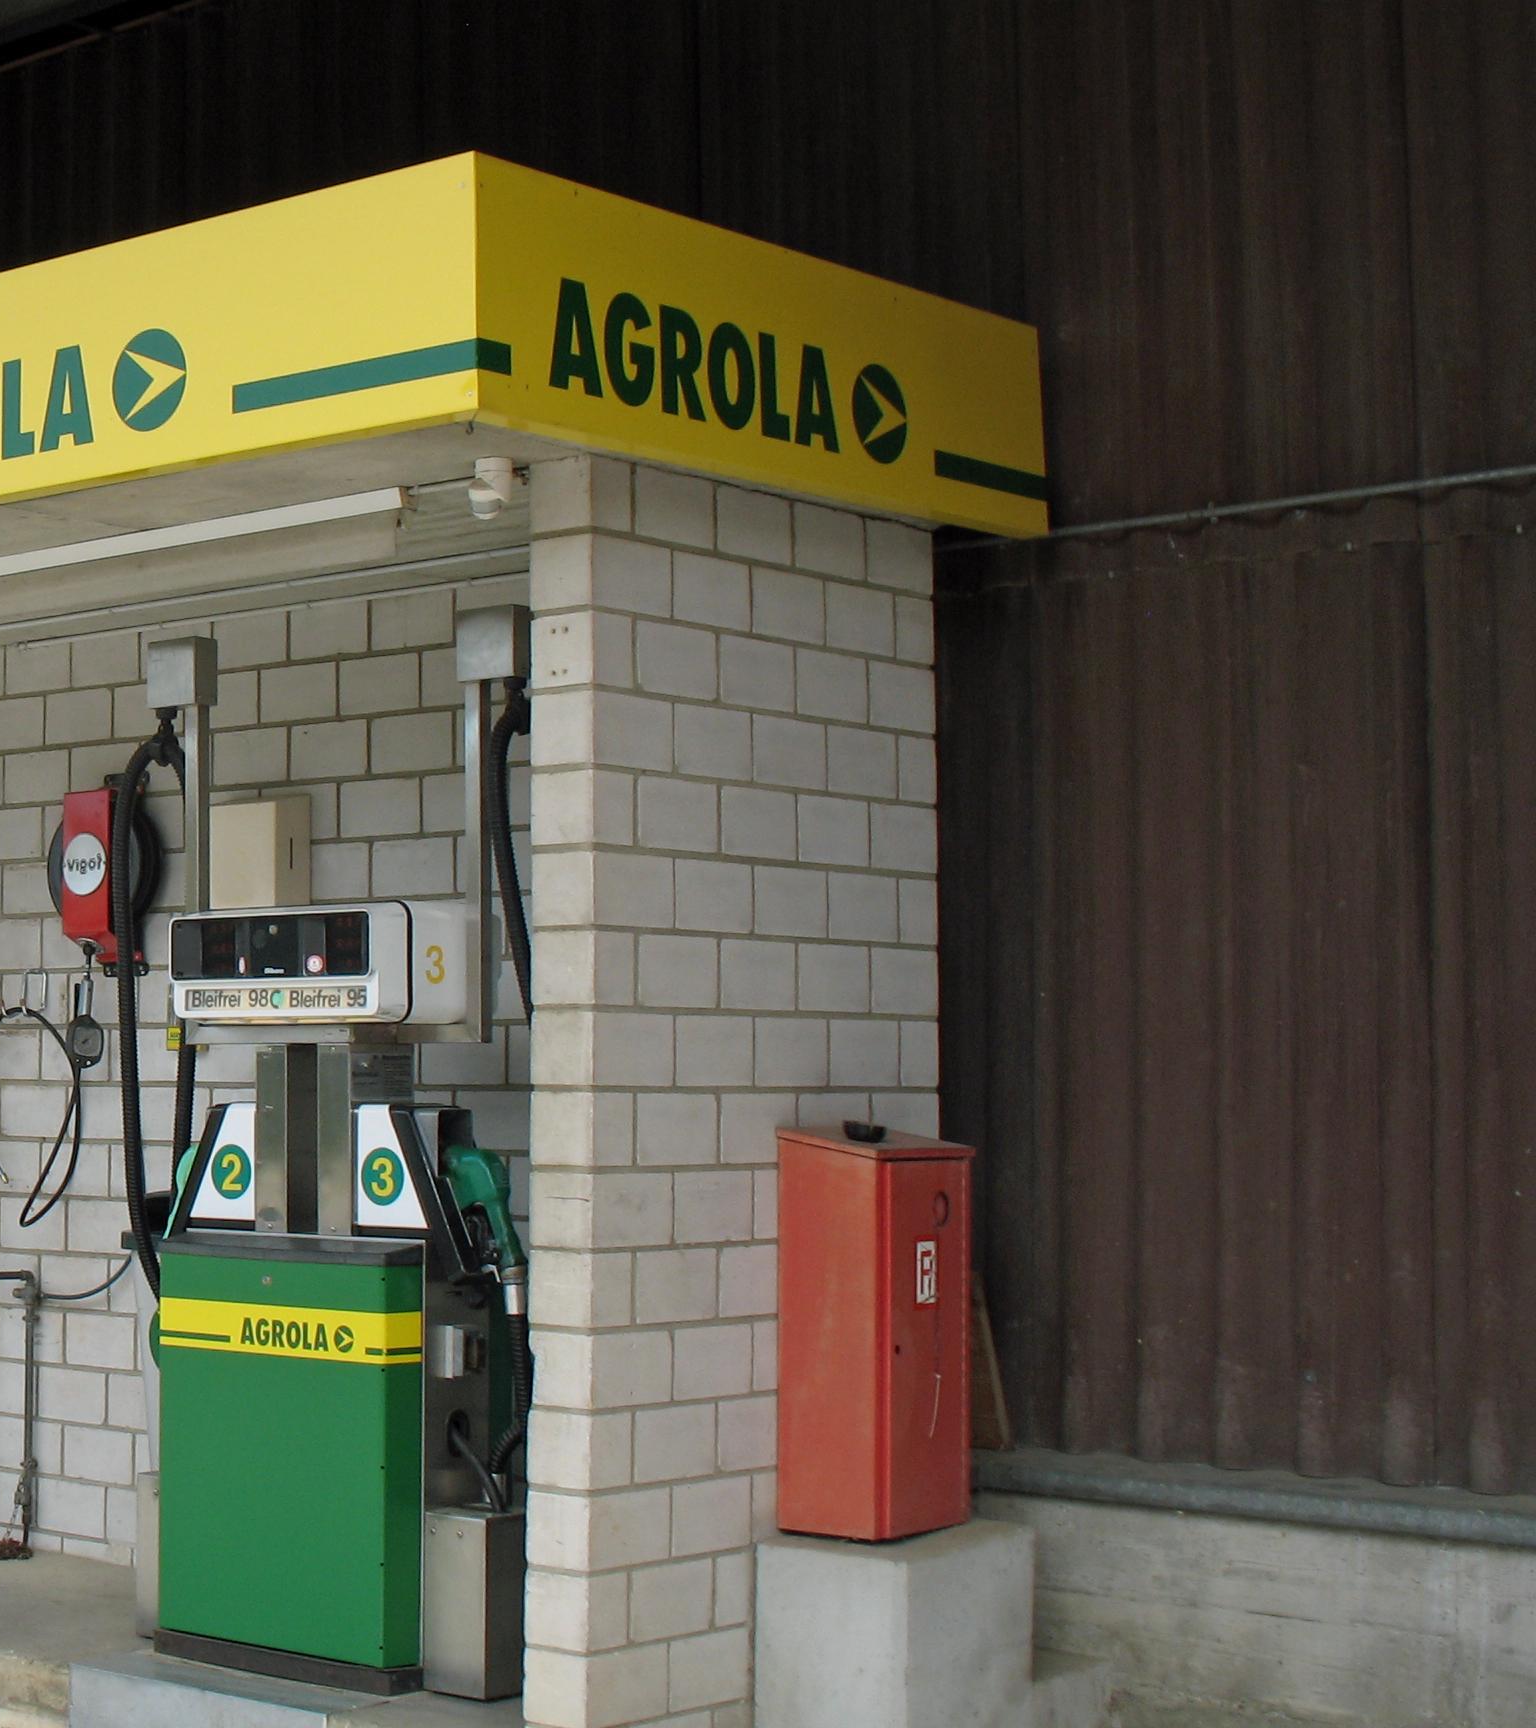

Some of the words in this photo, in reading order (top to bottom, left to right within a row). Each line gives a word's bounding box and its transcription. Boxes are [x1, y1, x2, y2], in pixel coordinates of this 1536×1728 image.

[549, 277, 841, 453] AGROLA
[425, 945, 446, 984] 3
[192, 989, 241, 1008] Bleifrei
[289, 989, 341, 1008] Bleifrei
[347, 988, 367, 1007] 95
[221, 1154, 242, 1191] 2
[371, 1156, 394, 1197] 3
[239, 1317, 329, 1352] AGROLA
